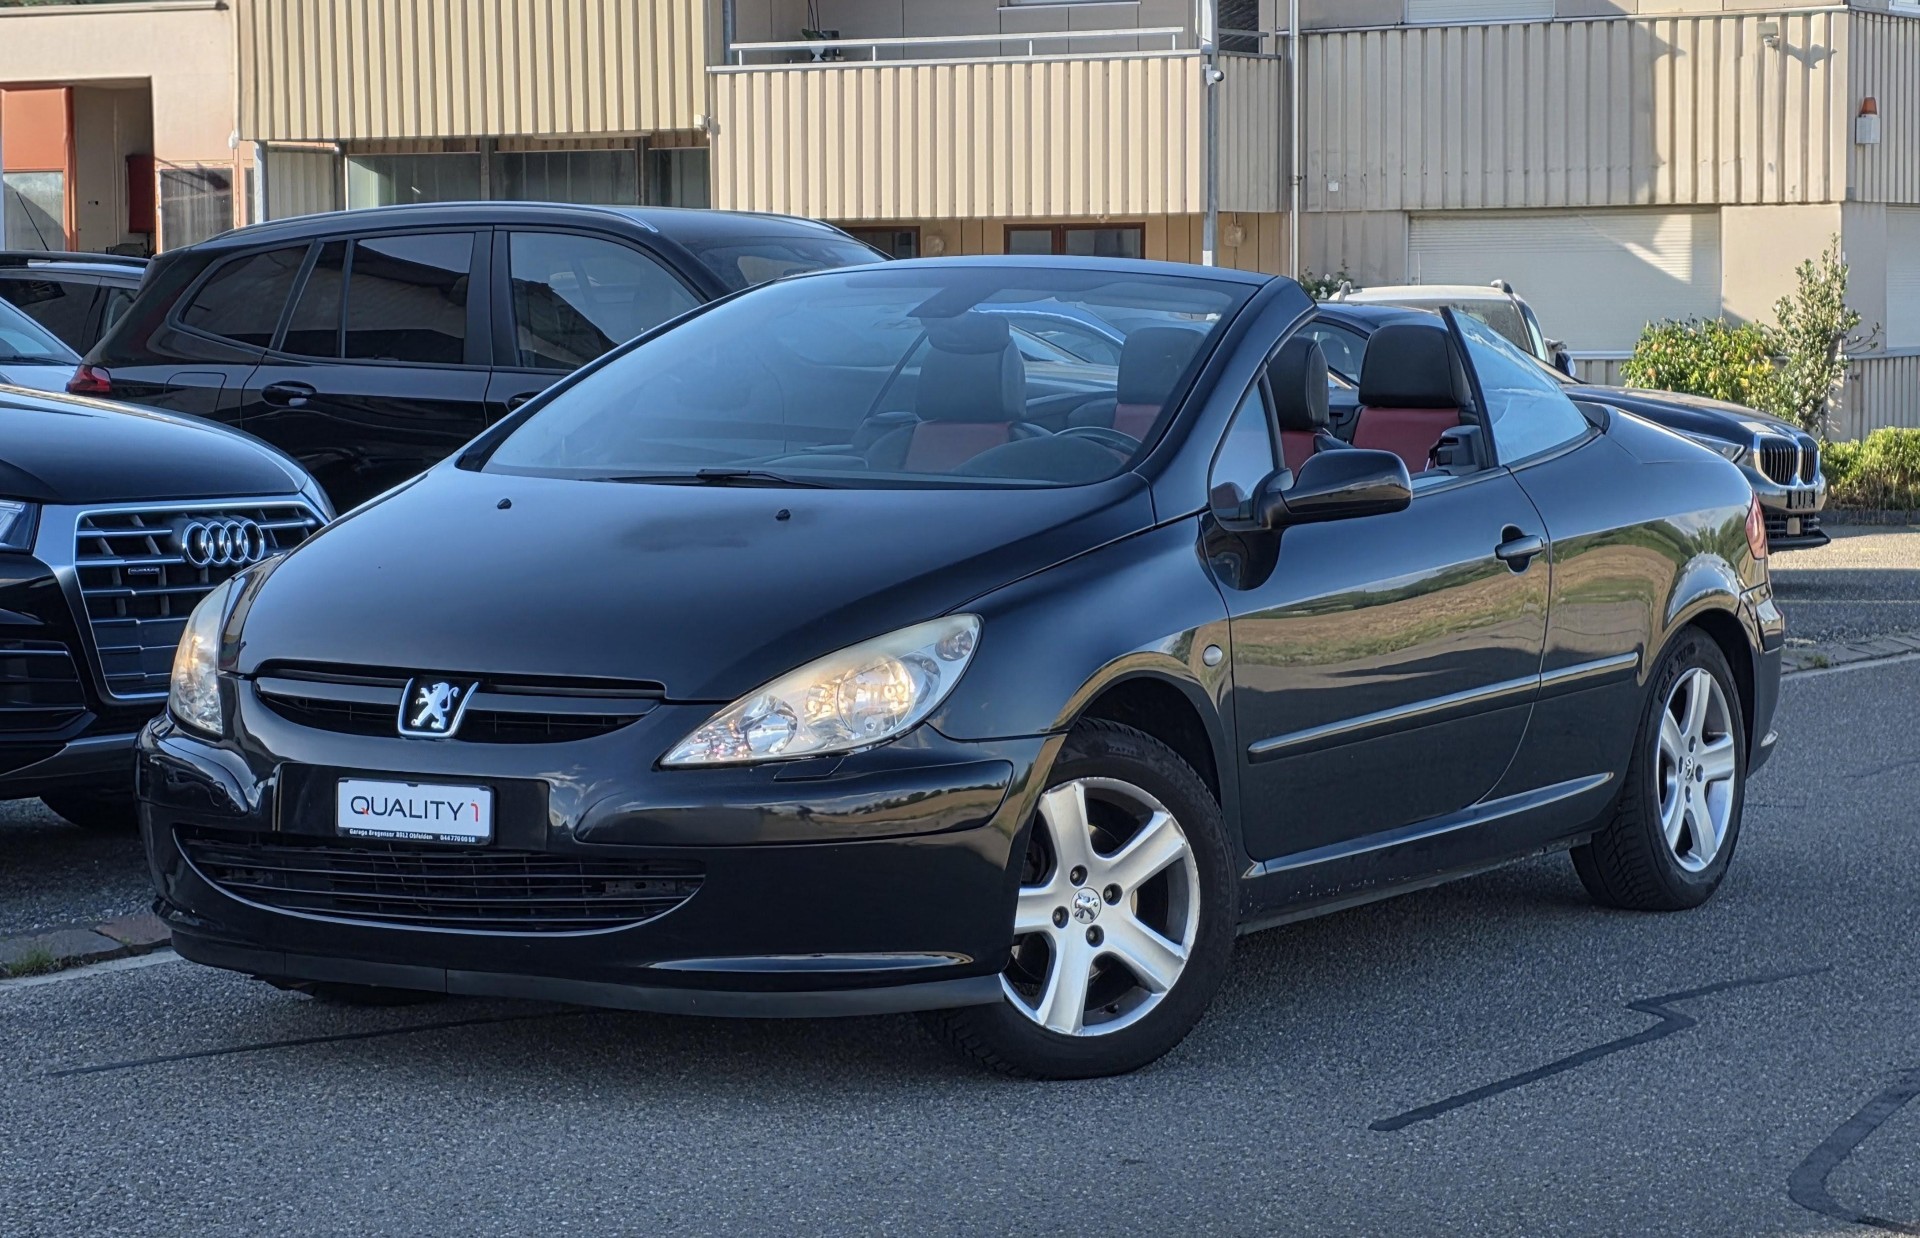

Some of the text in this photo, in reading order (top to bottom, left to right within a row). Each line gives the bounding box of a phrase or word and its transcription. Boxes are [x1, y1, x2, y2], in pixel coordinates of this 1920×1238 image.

[350, 795, 479, 822] QUALITY 1
[349, 828, 368, 837] Garage
